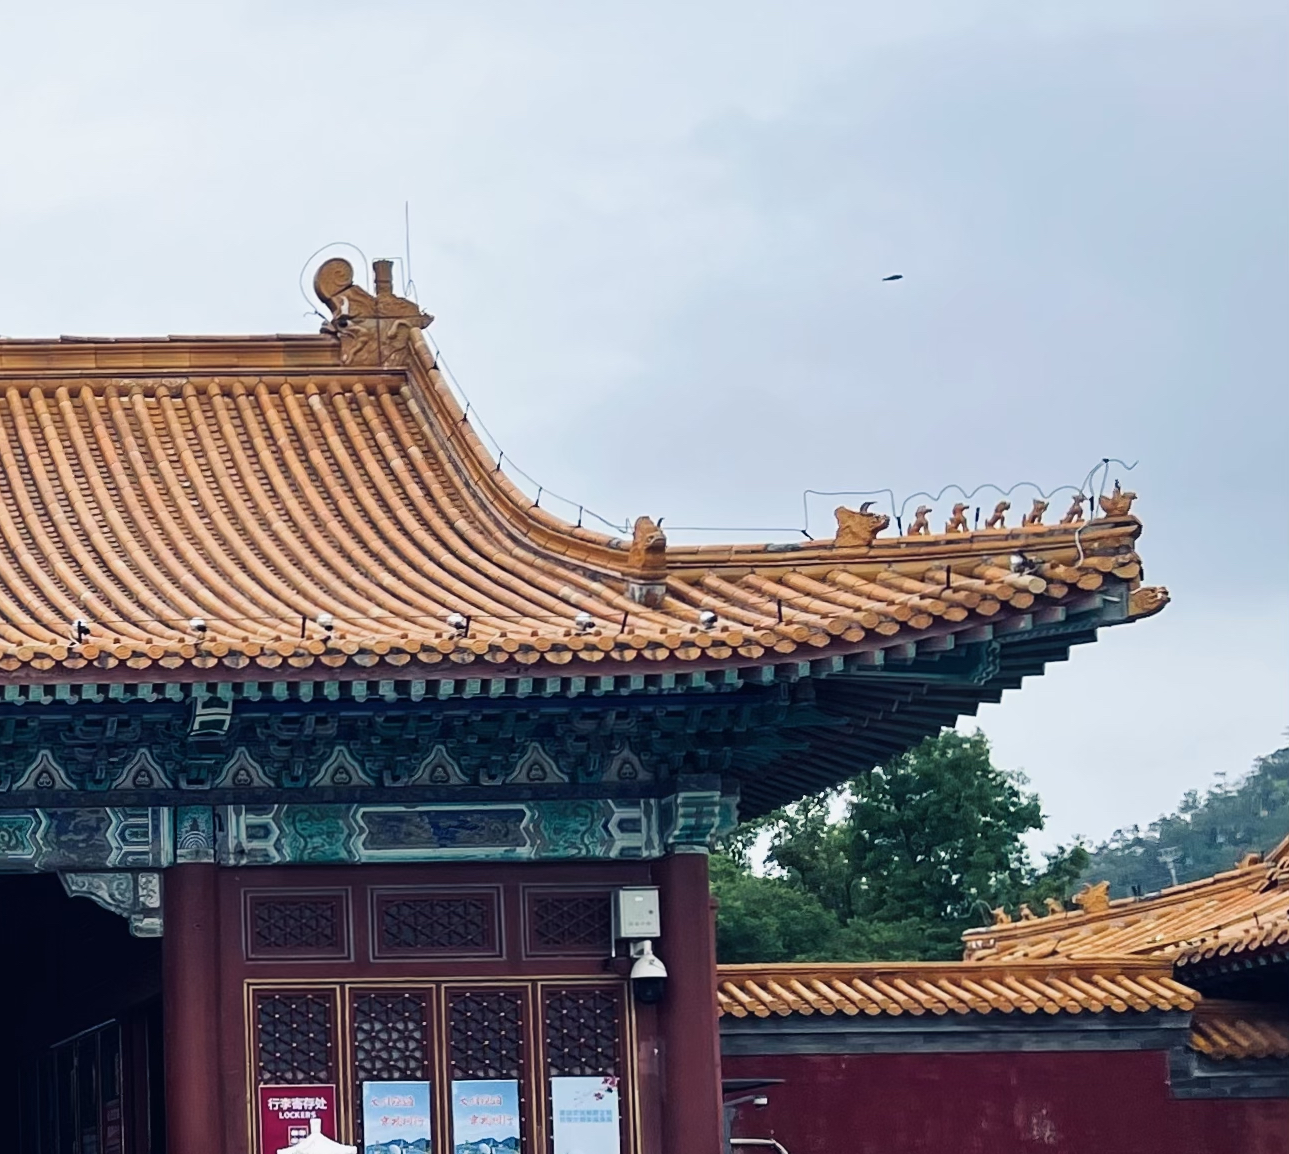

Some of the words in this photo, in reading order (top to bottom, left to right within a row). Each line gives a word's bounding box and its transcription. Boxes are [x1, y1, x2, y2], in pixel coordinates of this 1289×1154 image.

[267, 1097, 328, 1111] 行李寄存处
[279, 1111, 317, 1119] LOCKERS
